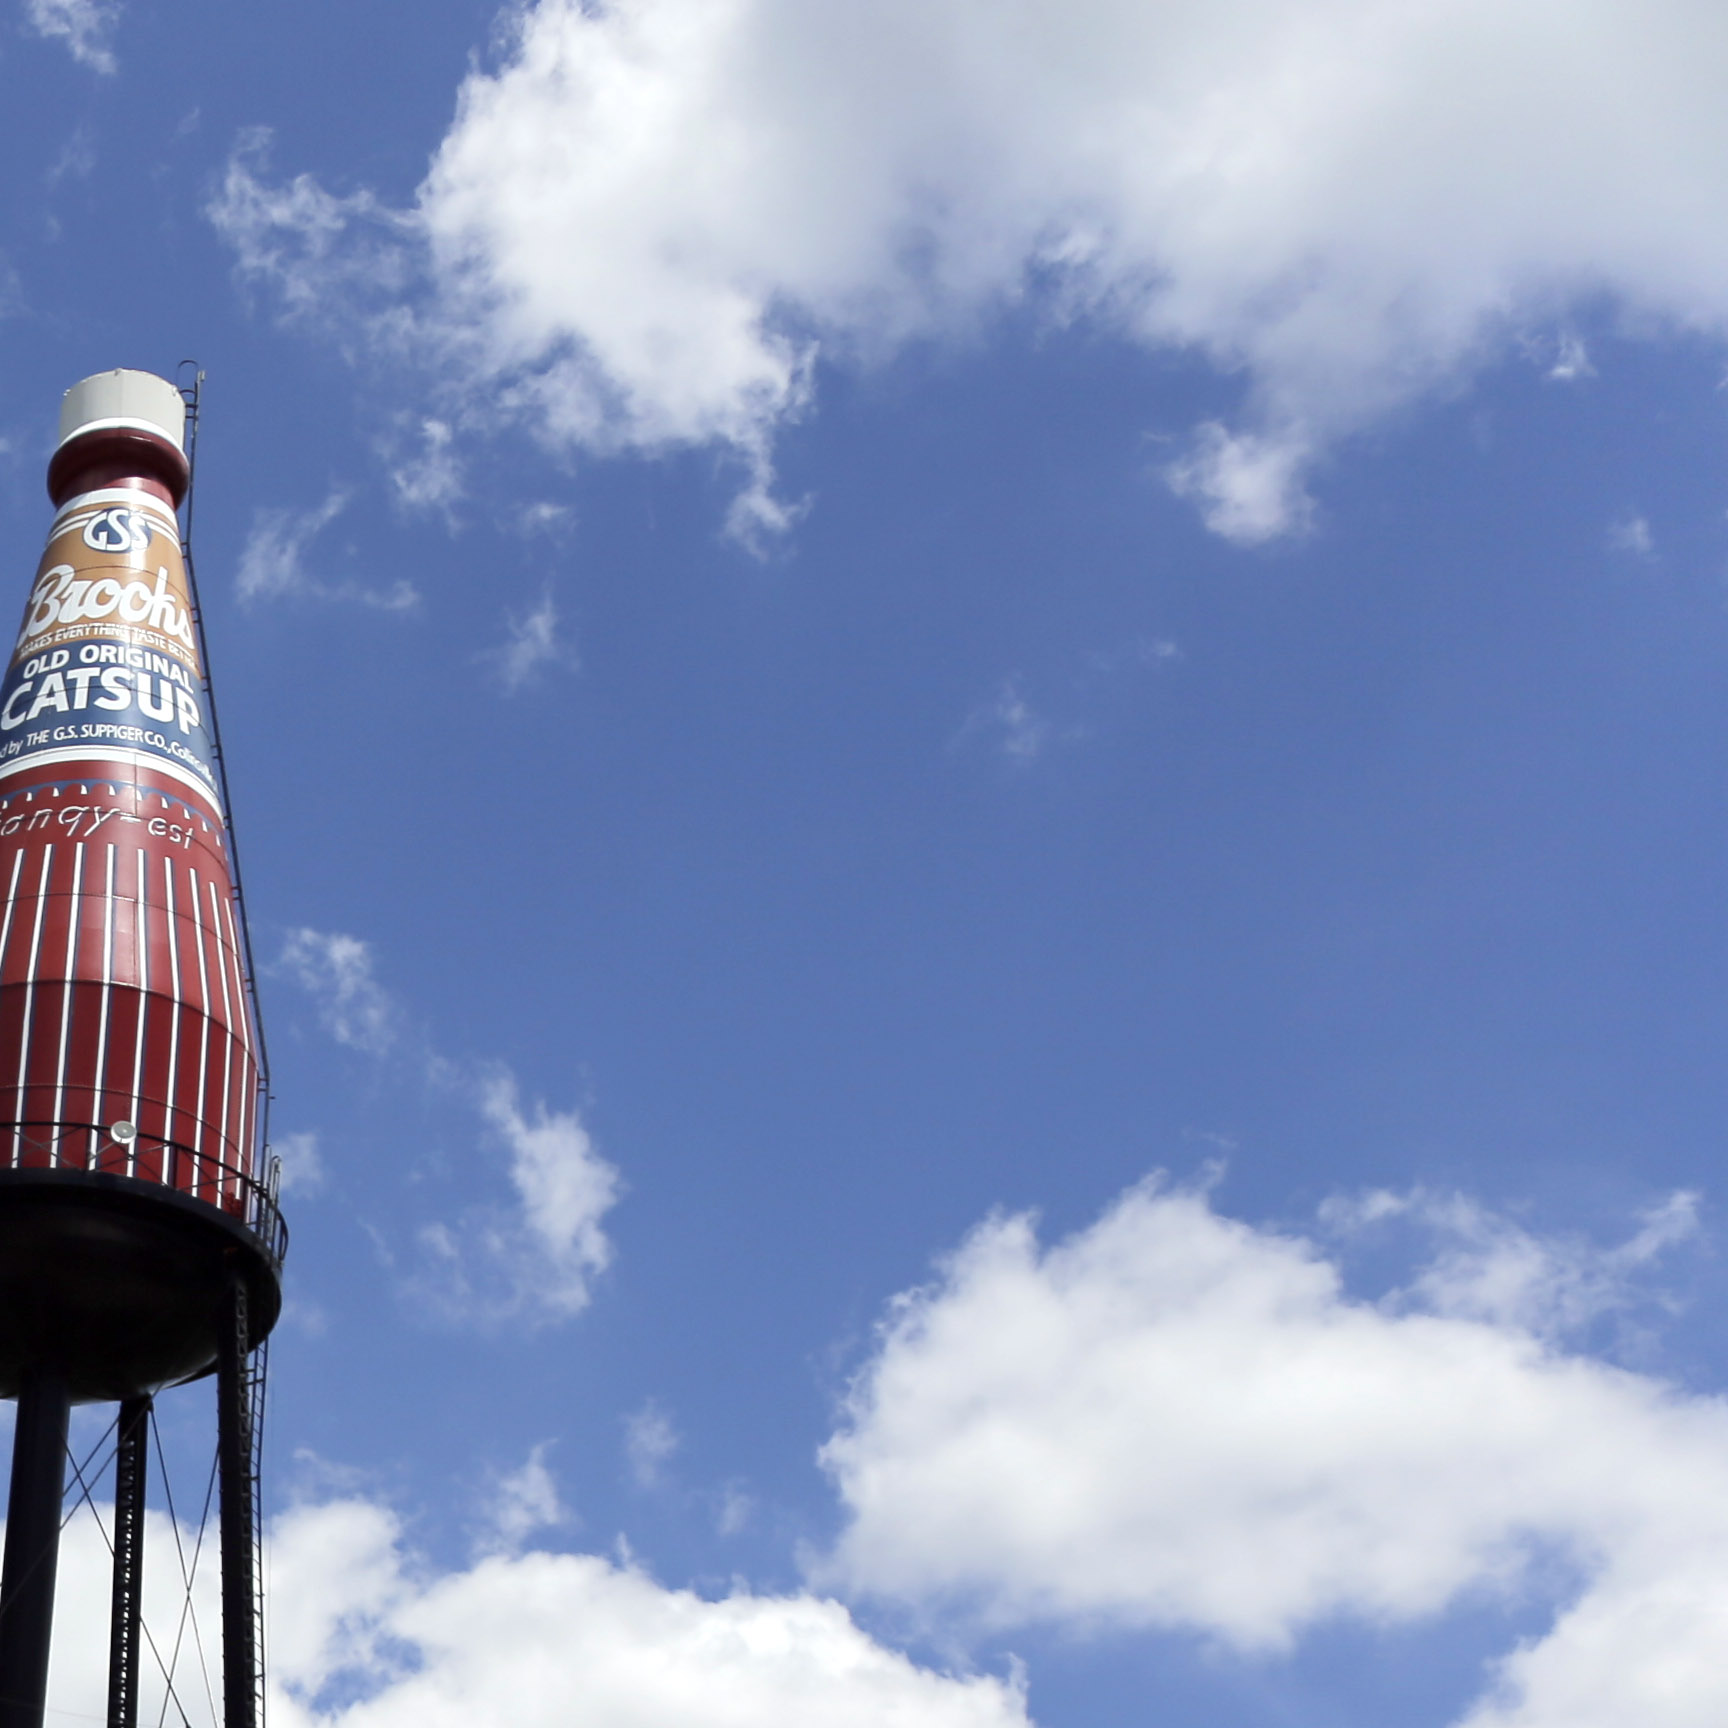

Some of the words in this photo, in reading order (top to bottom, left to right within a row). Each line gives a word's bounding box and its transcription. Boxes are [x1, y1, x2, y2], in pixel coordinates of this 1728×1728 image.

[17, 564, 195, 649] Brooks
[23, 649, 70, 679] OLD
[79, 644, 193, 694] ORIGINAL
[0, 667, 200, 735] CATSUP
[8, 740, 24, 755] by
[26, 729, 51, 746] THE
[53, 725, 79, 740] G.S.
[80, 723, 144, 743] SUPPIGER
